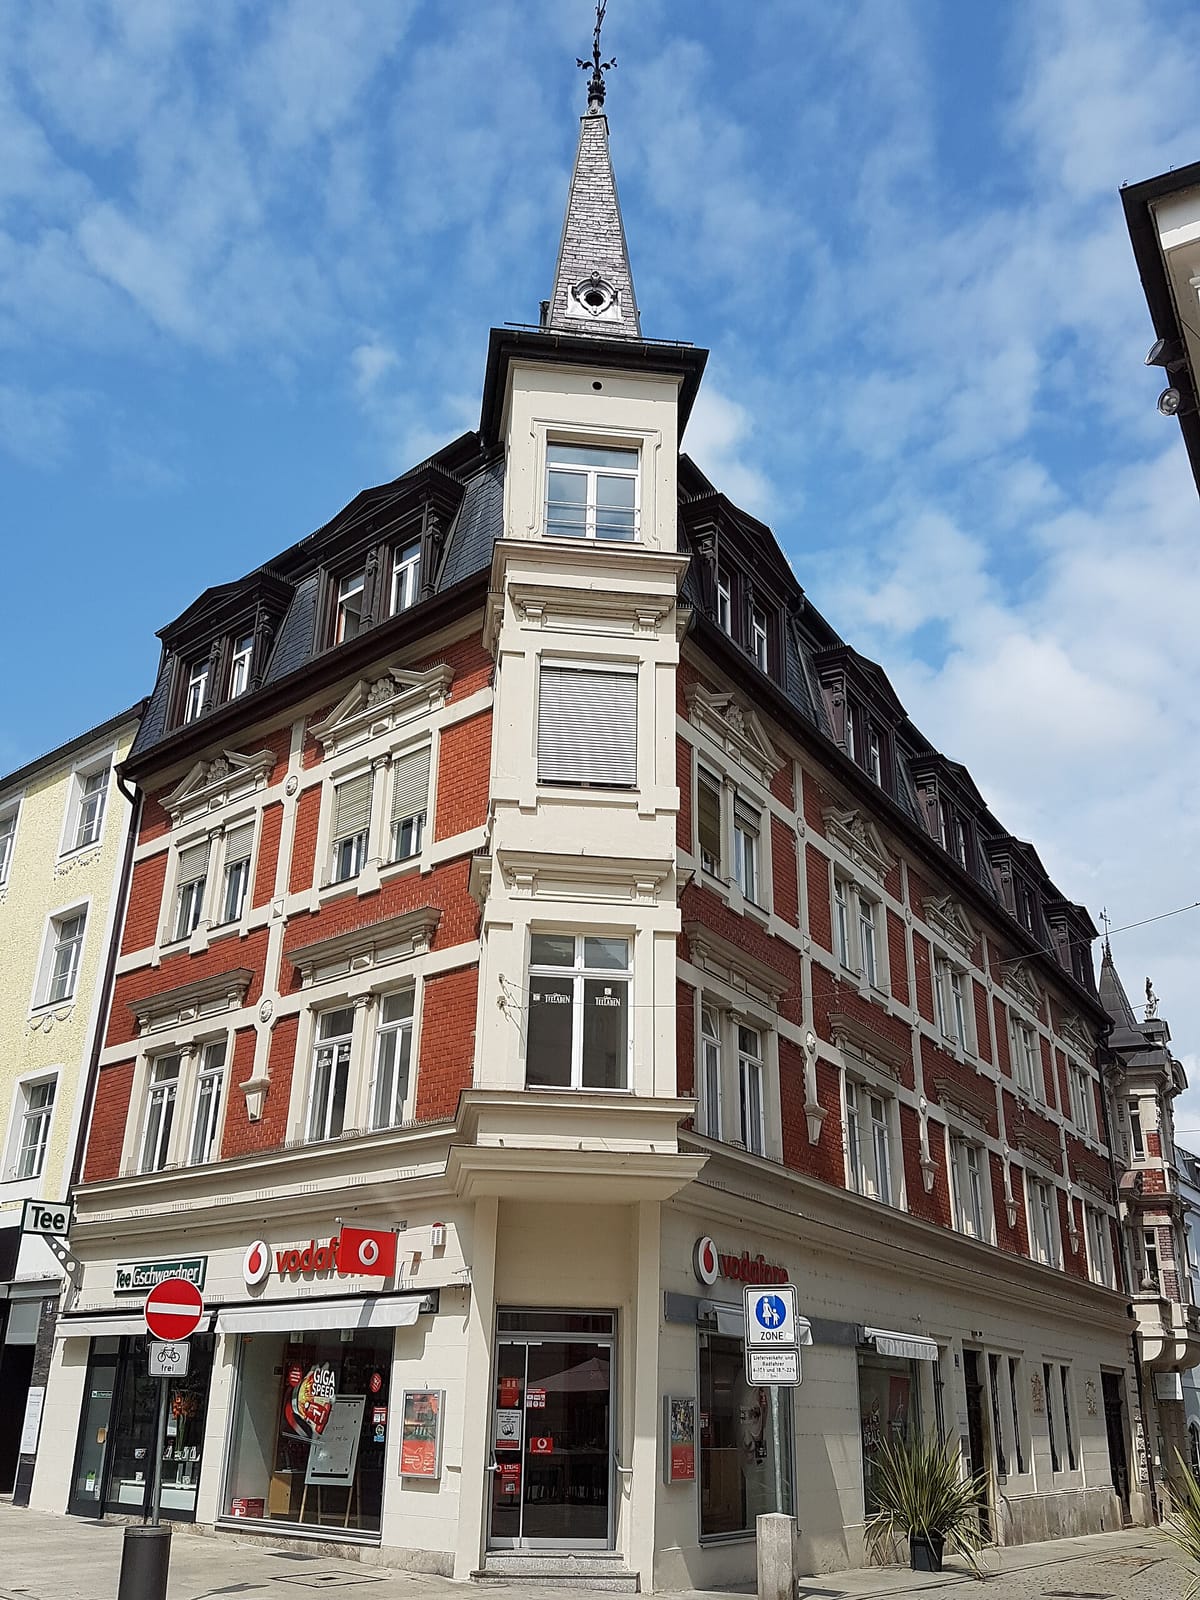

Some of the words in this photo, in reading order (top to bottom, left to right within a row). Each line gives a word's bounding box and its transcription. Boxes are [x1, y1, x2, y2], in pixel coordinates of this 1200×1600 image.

[31, 1206, 66, 1230] Tee
[116, 1269, 132, 1288] Tee
[760, 1331, 784, 1341] ZONE
[162, 1364, 176, 1372] frei
[313, 1367, 335, 1387] GIGA
[311, 1383, 335, 1398] SPEED
